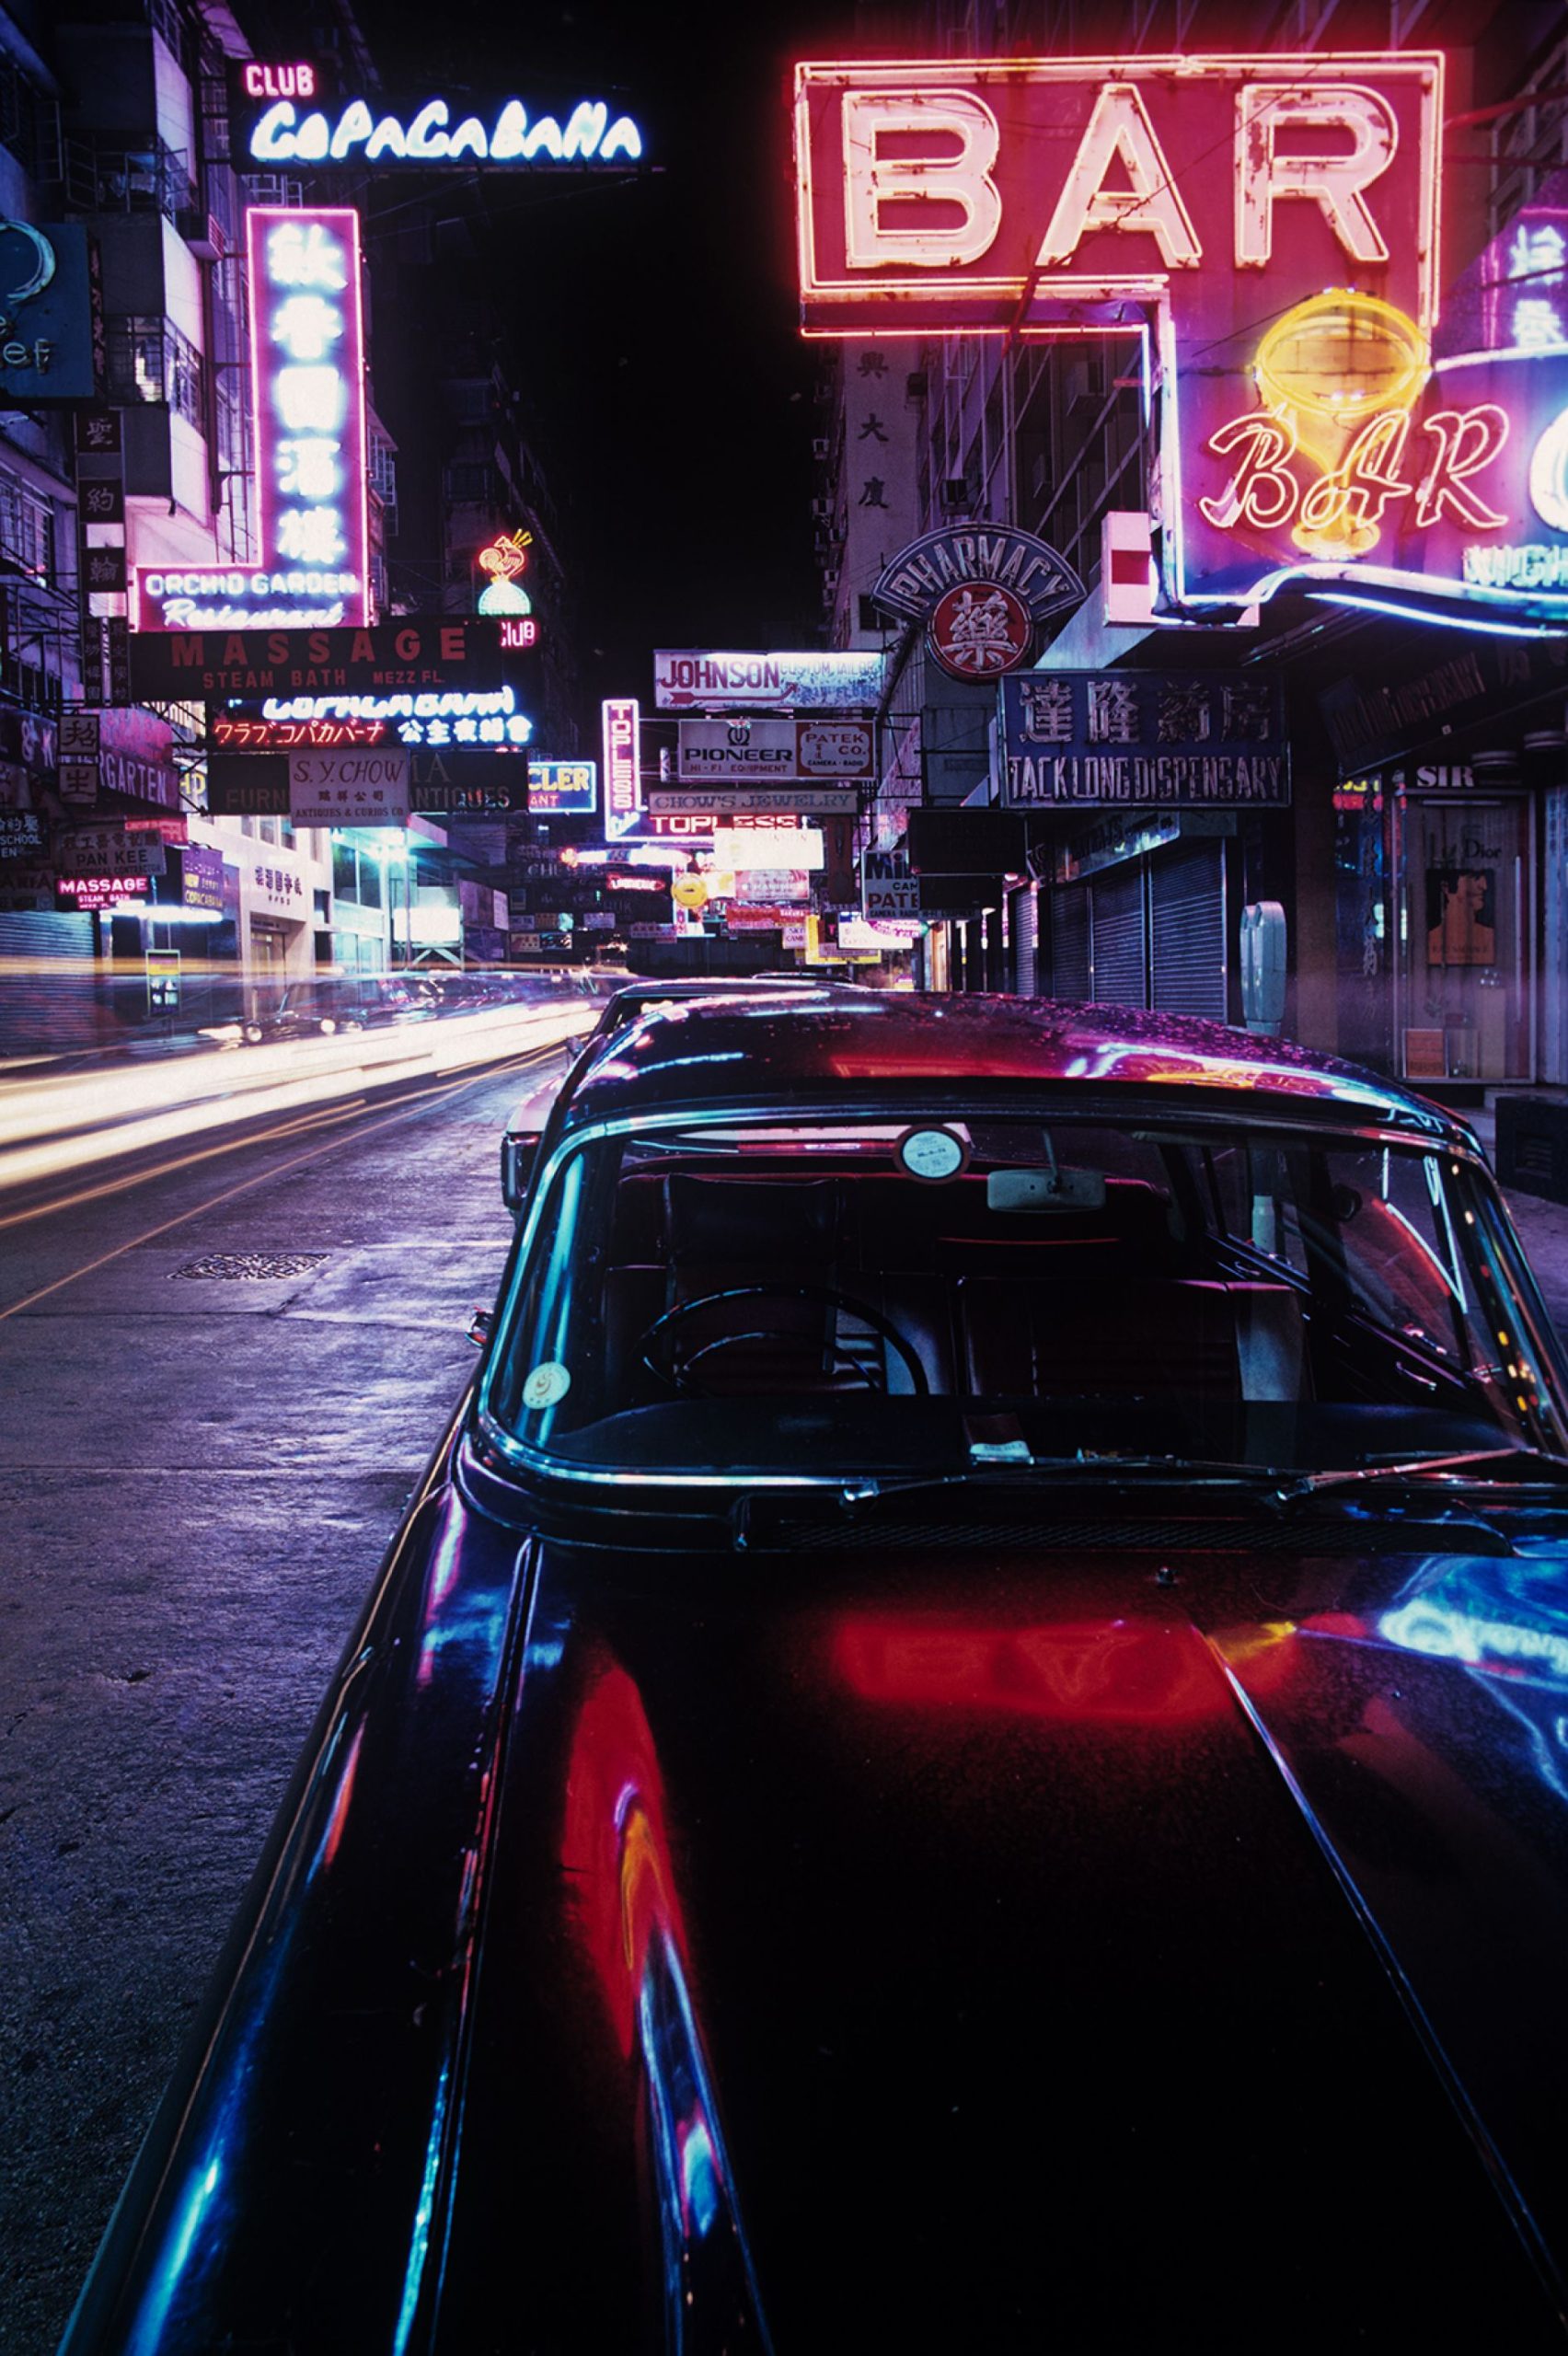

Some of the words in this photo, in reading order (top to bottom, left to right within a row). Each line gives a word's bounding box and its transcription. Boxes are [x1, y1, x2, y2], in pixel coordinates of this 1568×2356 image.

[246, 65, 314, 96] CLUB
[841, 83, 1399, 269] BAR
[1200, 403, 1510, 531] BAR
[889, 534, 1071, 608] PHARMACY
[145, 573, 244, 595] ORCHID
[250, 572, 358, 595] GARDEN
[162, 597, 343, 628] Restaurant
[171, 628, 467, 666] MASSAGE
[202, 671, 274, 689] STEAM
[291, 669, 346, 687] BATH
[373, 670, 416, 685] MEZZ
[660, 660, 779, 689] JOHNSON
[805, 733, 864, 744] PATEK
[611, 705, 632, 809] TOPLESS
[685, 748, 793, 762] PIONEER
[838, 745, 867, 755] CO.
[340, 759, 405, 784] CHOW
[1009, 756, 1067, 800] TACK
[1071, 756, 1130, 800] LONG
[1415, 765, 1476, 788] SIR
[654, 794, 736, 809] CHOW'S
[741, 793, 851, 809] JEWELRY
[295, 807, 341, 818] ANTIQUES
[355, 807, 388, 817] CURIOS
[0, 833, 42, 846] SCHOOL
[1464, 837, 1503, 859] Dior
[76, 851, 108, 867] PAN
[115, 849, 148, 864] KEE
[58, 877, 148, 895] MASSAGE
[78, 894, 104, 903] STEAM
[870, 908, 896, 918] CAMERA
